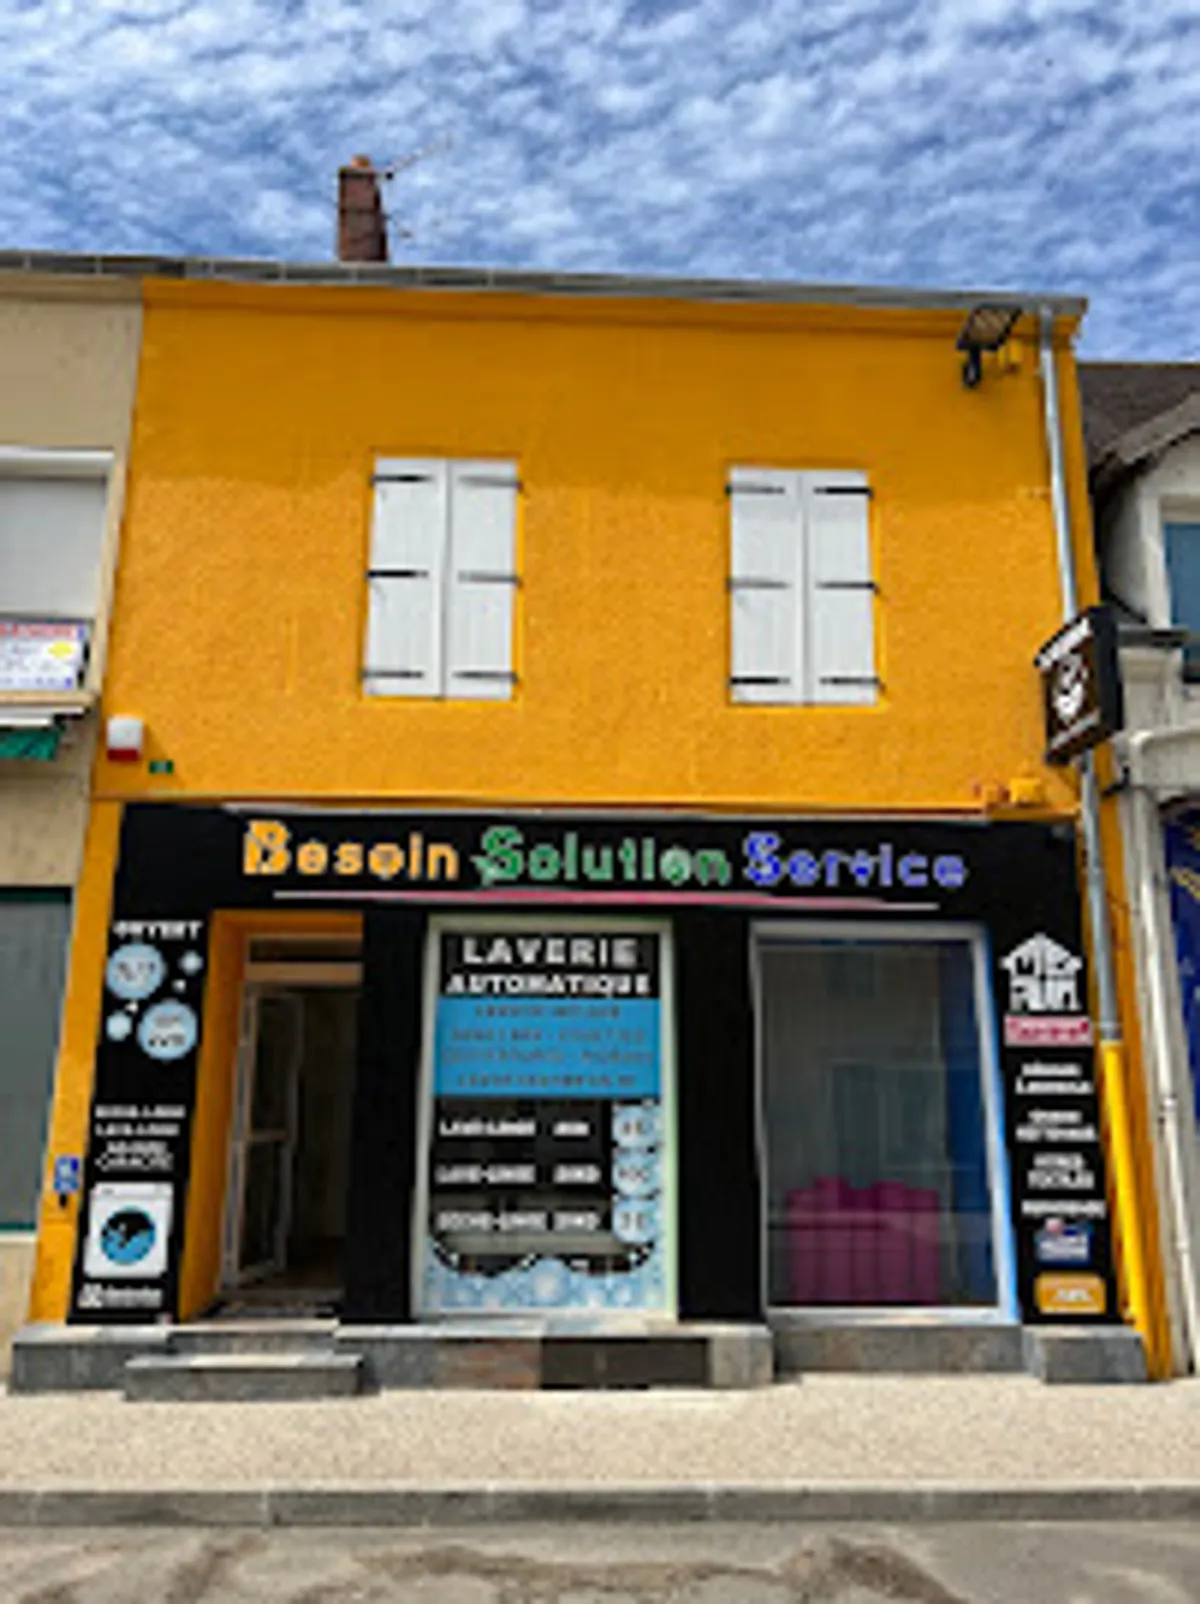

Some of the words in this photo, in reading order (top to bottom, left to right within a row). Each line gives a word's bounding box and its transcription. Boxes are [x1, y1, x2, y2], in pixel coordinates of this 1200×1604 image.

[242, 819, 459, 879] Besoin
[471, 825, 731, 887] Solution
[742, 832, 968, 888] Service
[462, 937, 638, 968] LAVERIE
[445, 973, 653, 998] AUTOMATIQUE
